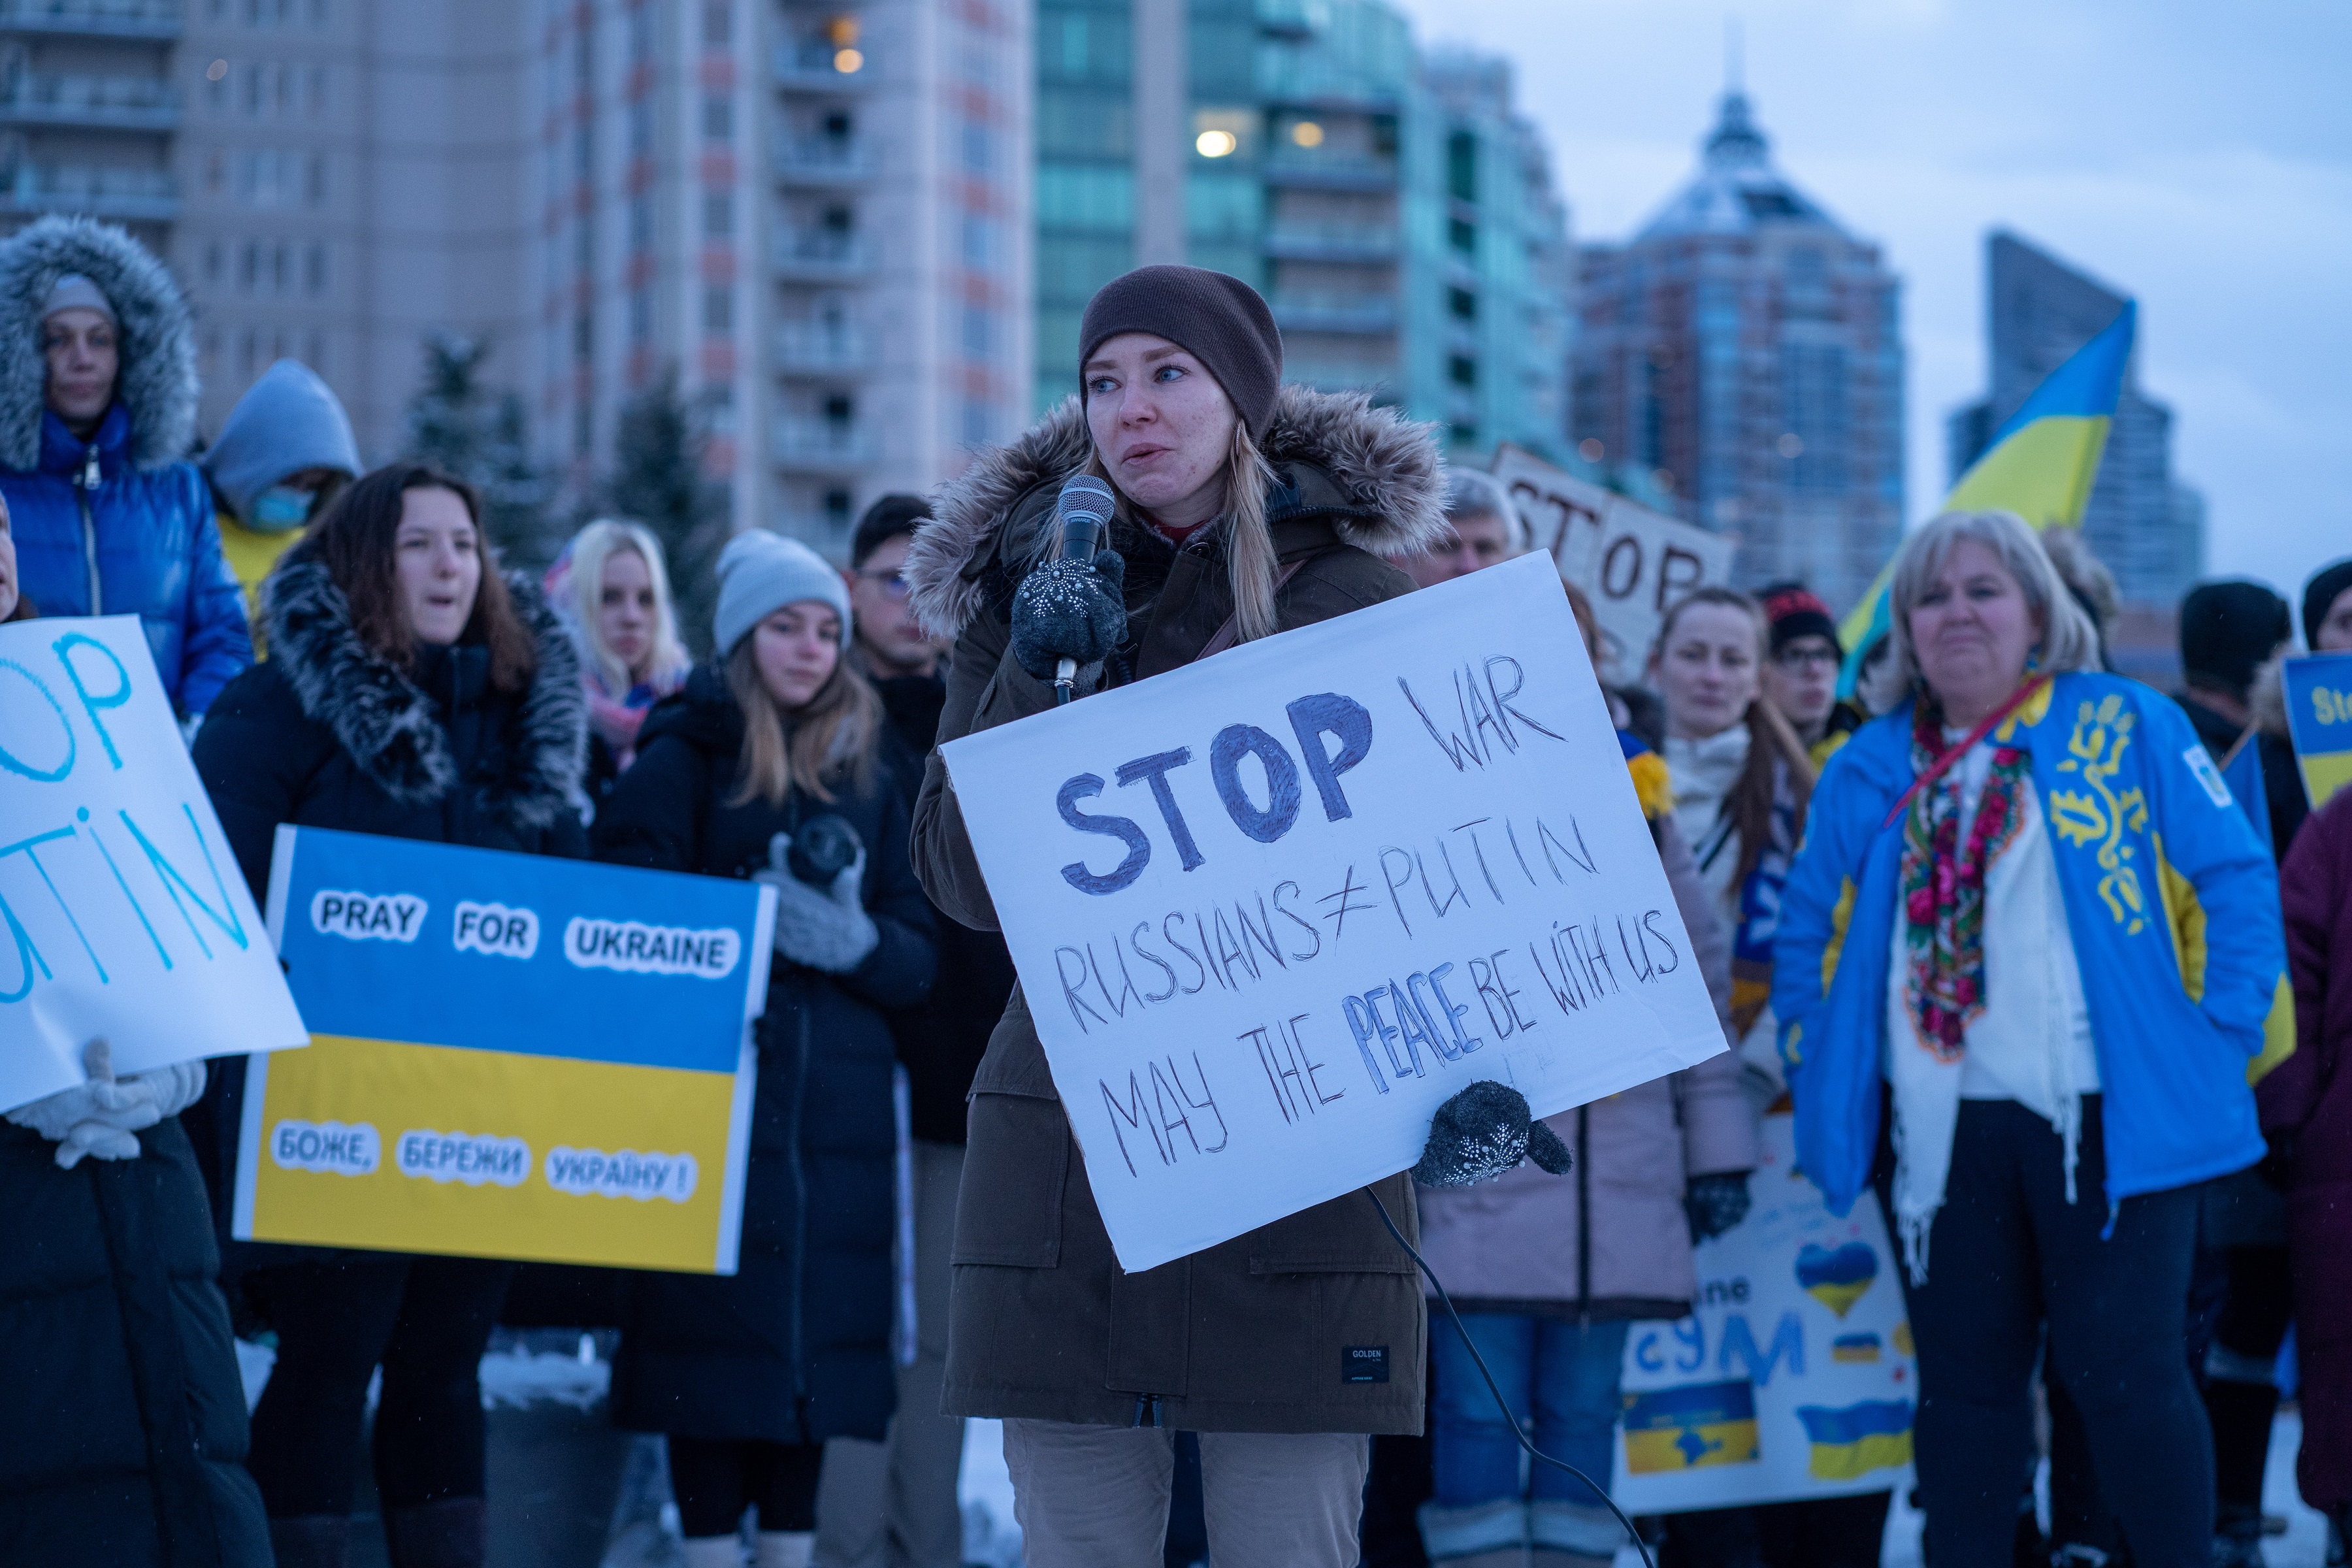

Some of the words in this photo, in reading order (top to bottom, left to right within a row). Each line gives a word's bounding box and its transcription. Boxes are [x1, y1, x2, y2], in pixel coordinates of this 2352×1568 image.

[1056, 691, 1373, 896] STOP
[1396, 654, 1569, 773] WAR
[321, 896, 416, 934] PRAY
[459, 911, 530, 949] FOR
[575, 924, 728, 969] UKRAINE
[1378, 813, 1600, 940] PUTIN
[1100, 1049, 1228, 1178] MAY
[1236, 1012, 1347, 1126] THE
[1342, 961, 1484, 1095] PEACE
[1467, 949, 1538, 1042] BE
[1615, 909, 1679, 985] US
[278, 1127, 374, 1172] БОЖЕ,
[403, 1135, 522, 1177] БЕРЕЖИ
